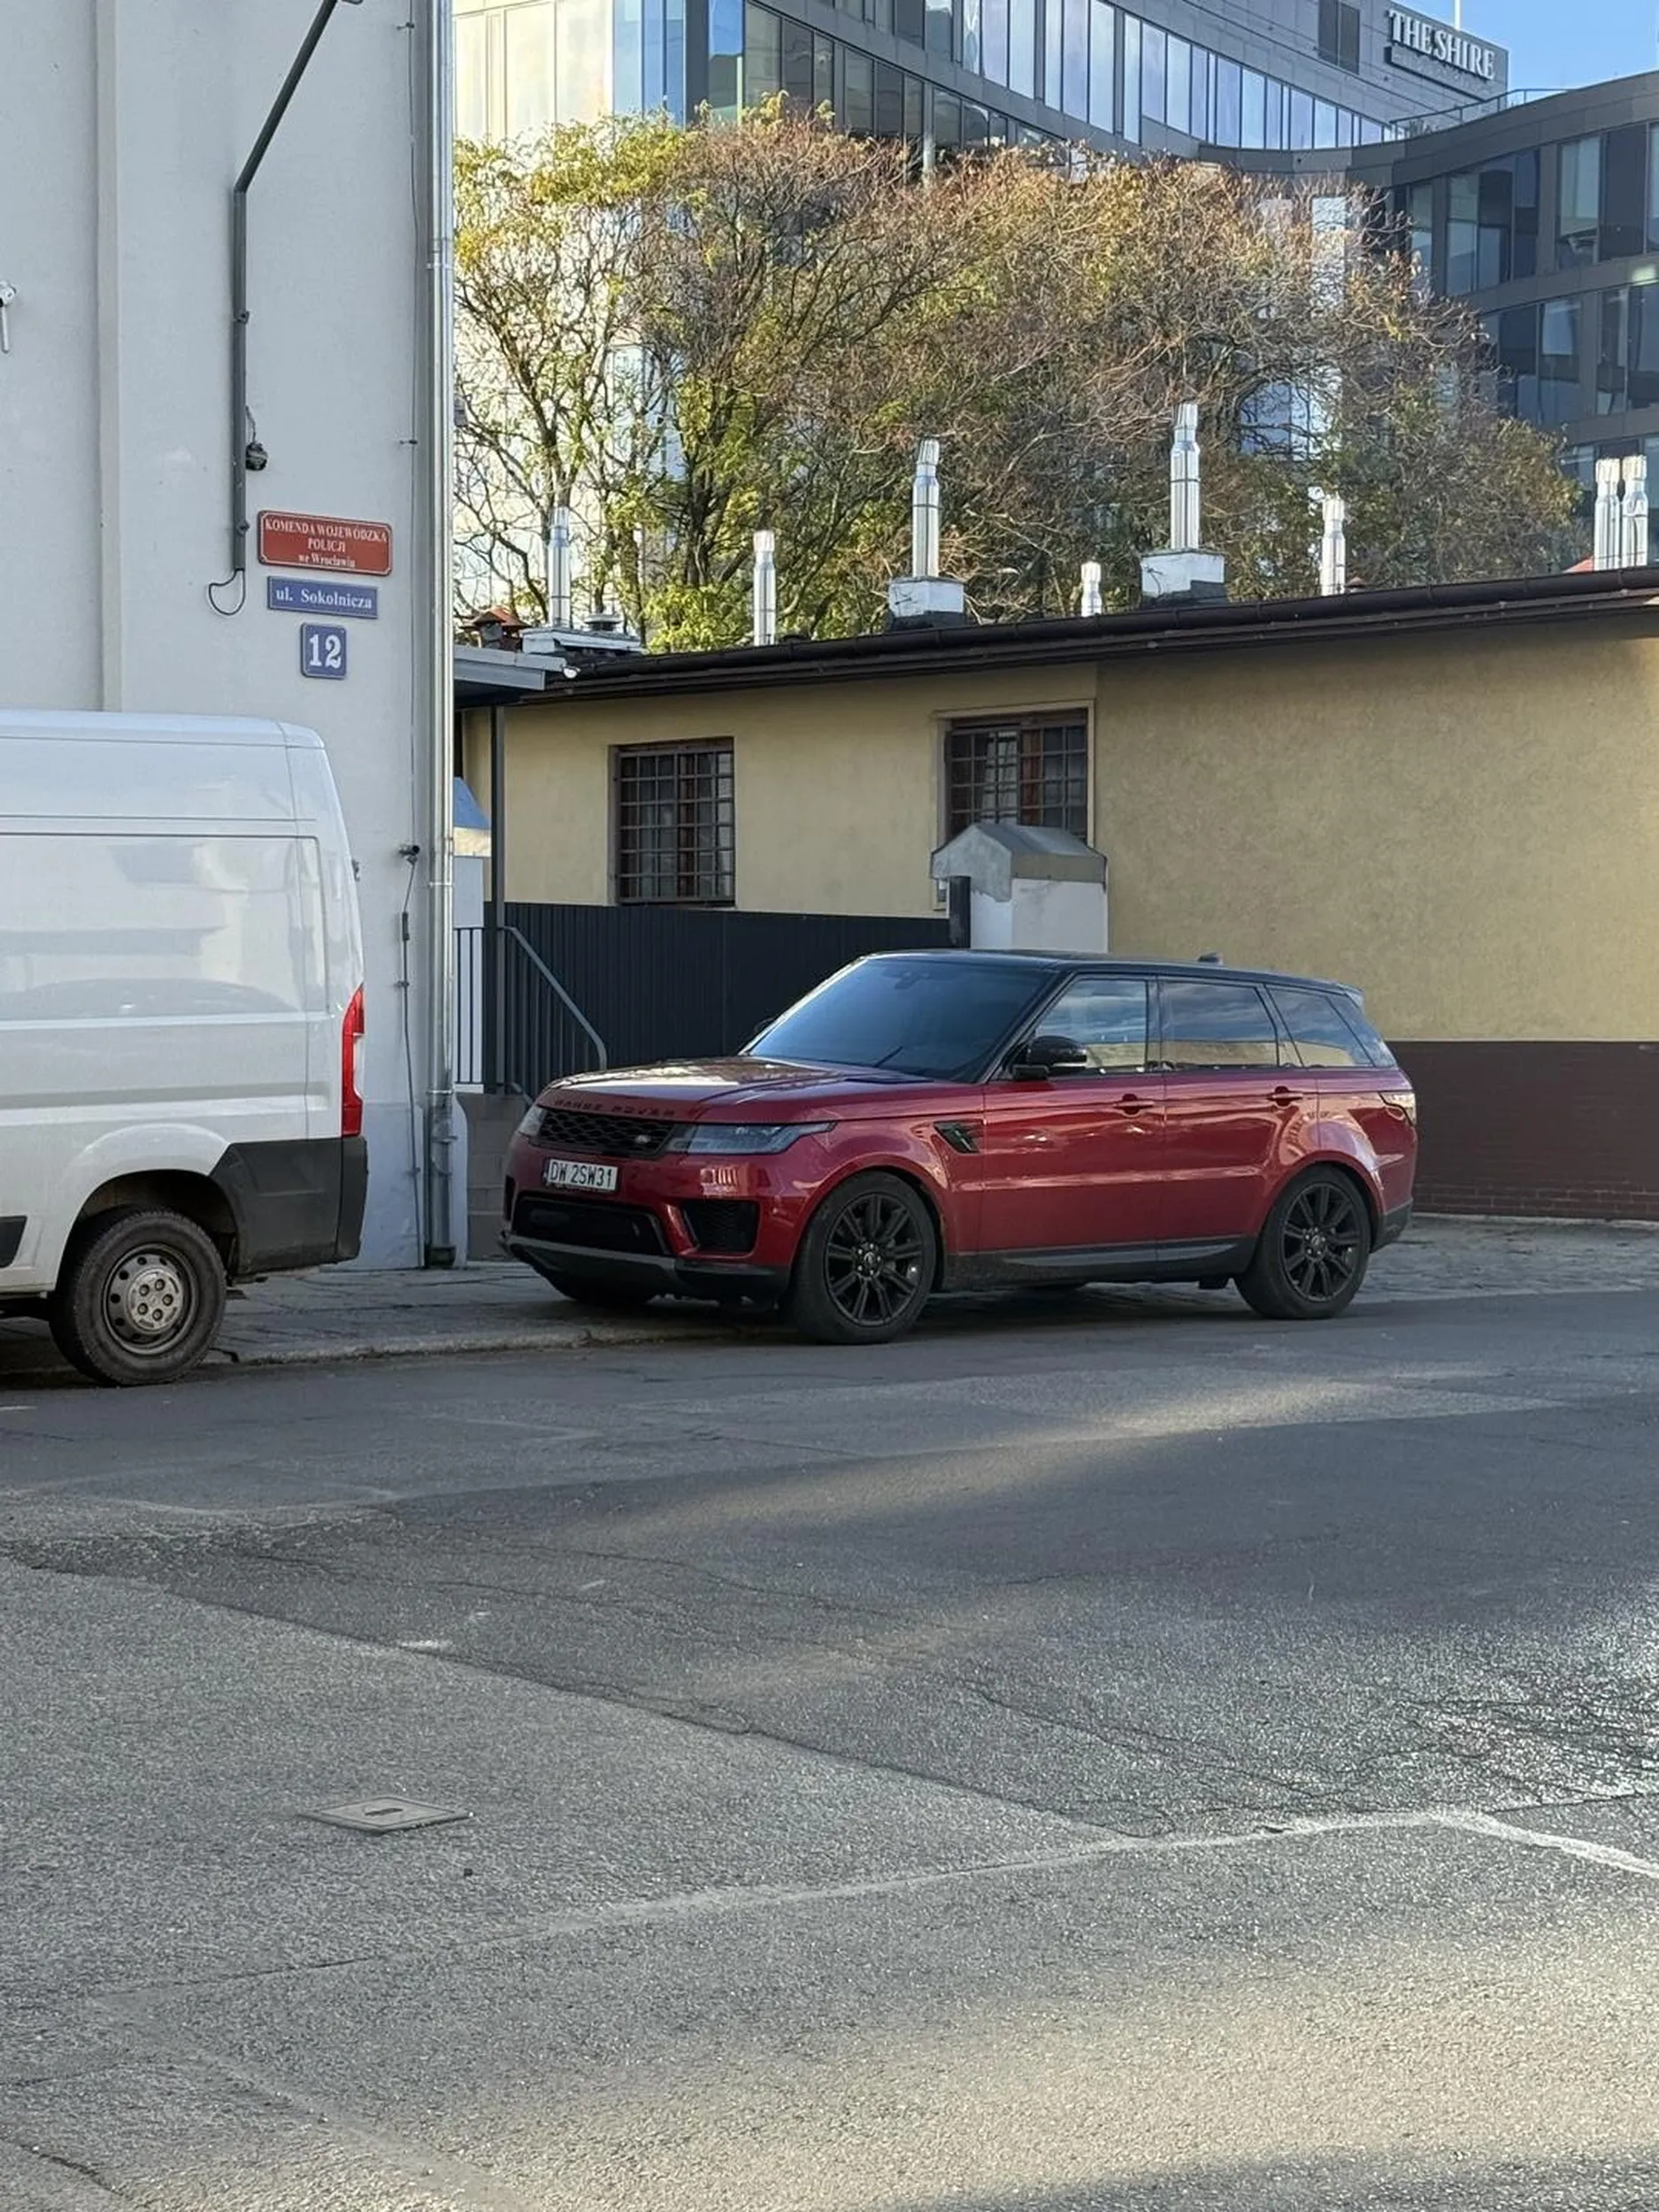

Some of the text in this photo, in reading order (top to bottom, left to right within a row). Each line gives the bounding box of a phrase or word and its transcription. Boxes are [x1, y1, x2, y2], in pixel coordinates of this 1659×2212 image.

[1388, 9, 1432, 54] THE
[1434, 30, 1495, 80] SHIRE
[265, 518, 316, 534] KOMENDA
[308, 538, 346, 552] POLICJI
[276, 587, 373, 609] ul. Sokolnicza
[309, 634, 342, 669] 12
[549, 1161, 612, 1187] DW 2SW31
